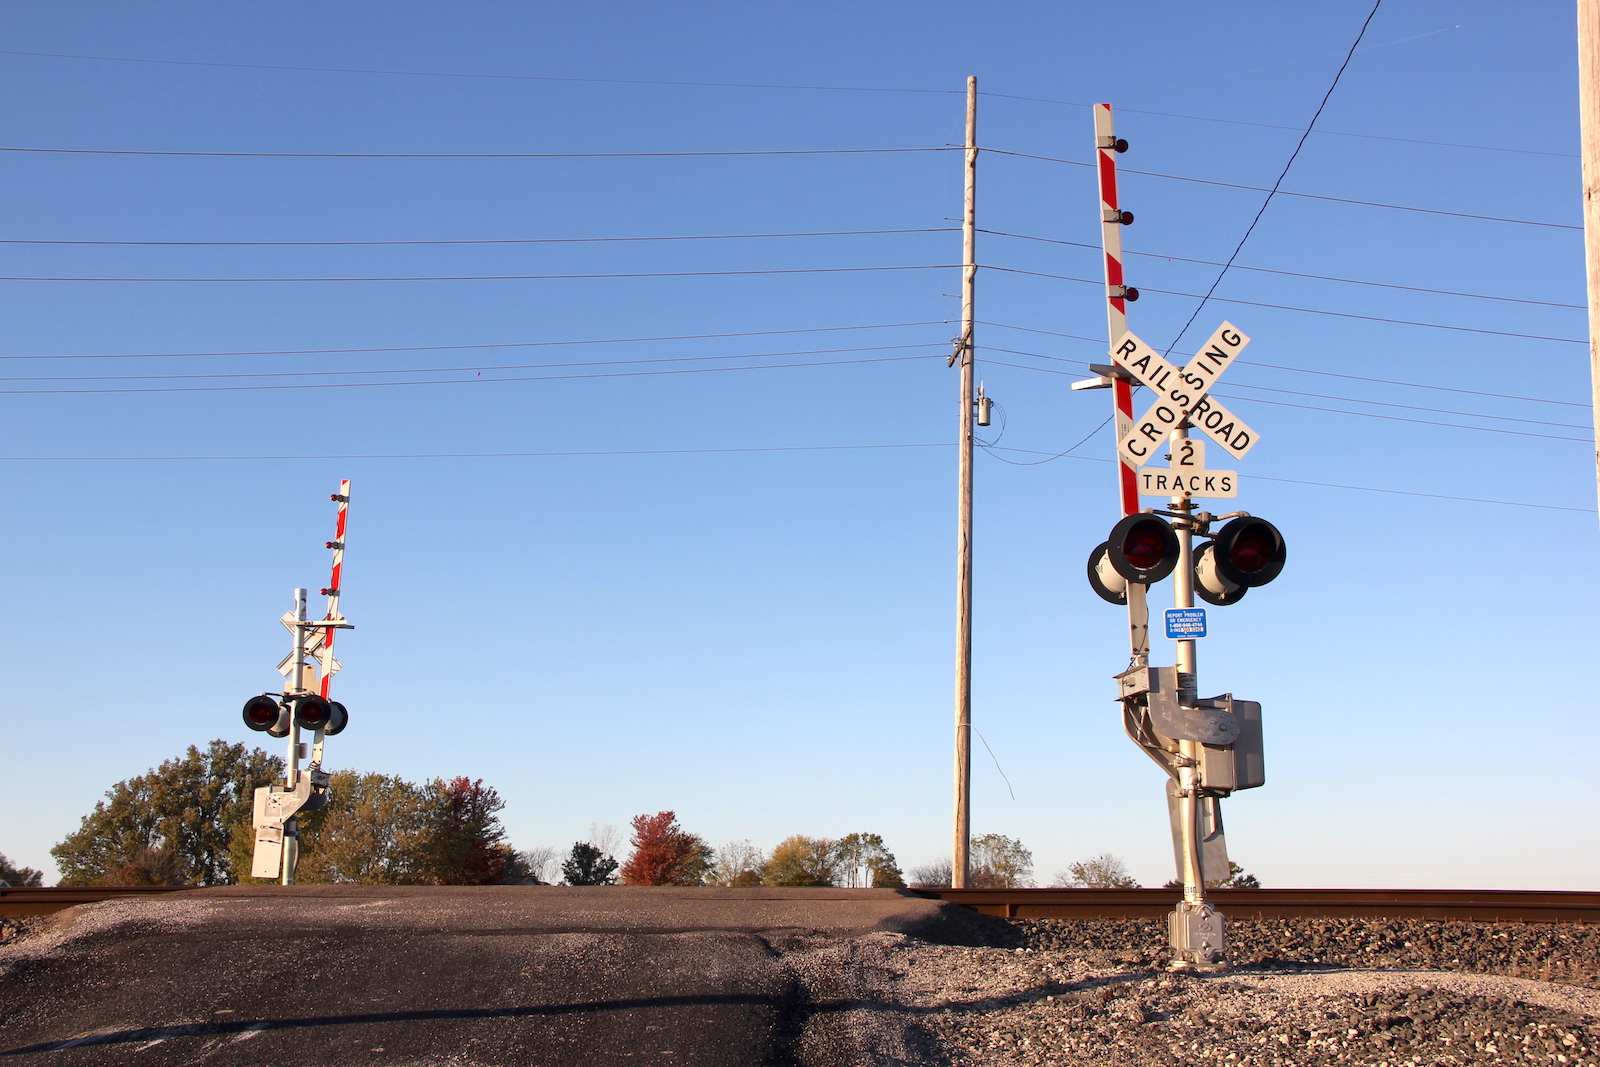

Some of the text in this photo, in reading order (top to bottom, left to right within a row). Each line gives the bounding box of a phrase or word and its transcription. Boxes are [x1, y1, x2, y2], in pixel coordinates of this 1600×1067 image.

[1116, 339, 1250, 451] RAIL ROAD
[1127, 329, 1241, 457] CROSSING
[1142, 474, 1231, 492] TRACKS
[1180, 446, 1194, 466] 2
